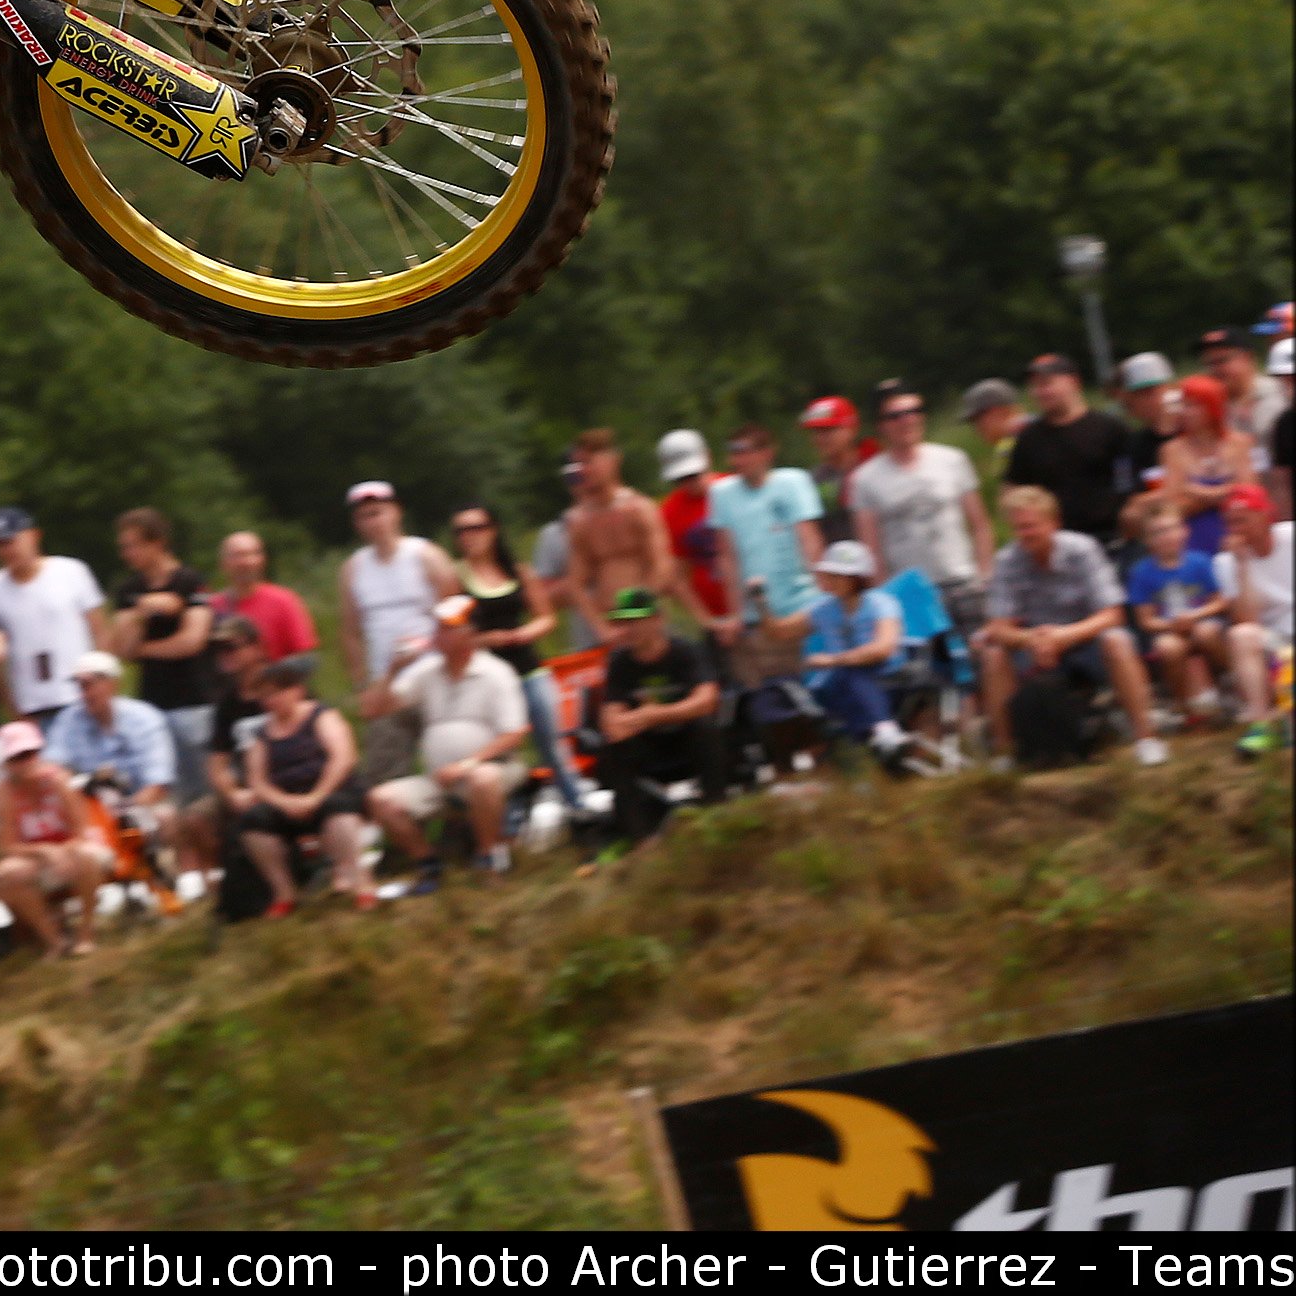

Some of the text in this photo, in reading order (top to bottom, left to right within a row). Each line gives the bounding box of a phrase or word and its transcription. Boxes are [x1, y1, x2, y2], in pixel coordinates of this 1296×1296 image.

[60, 48, 160, 106] ENERGY DRINK
[55, 75, 182, 149] ACERBIS
